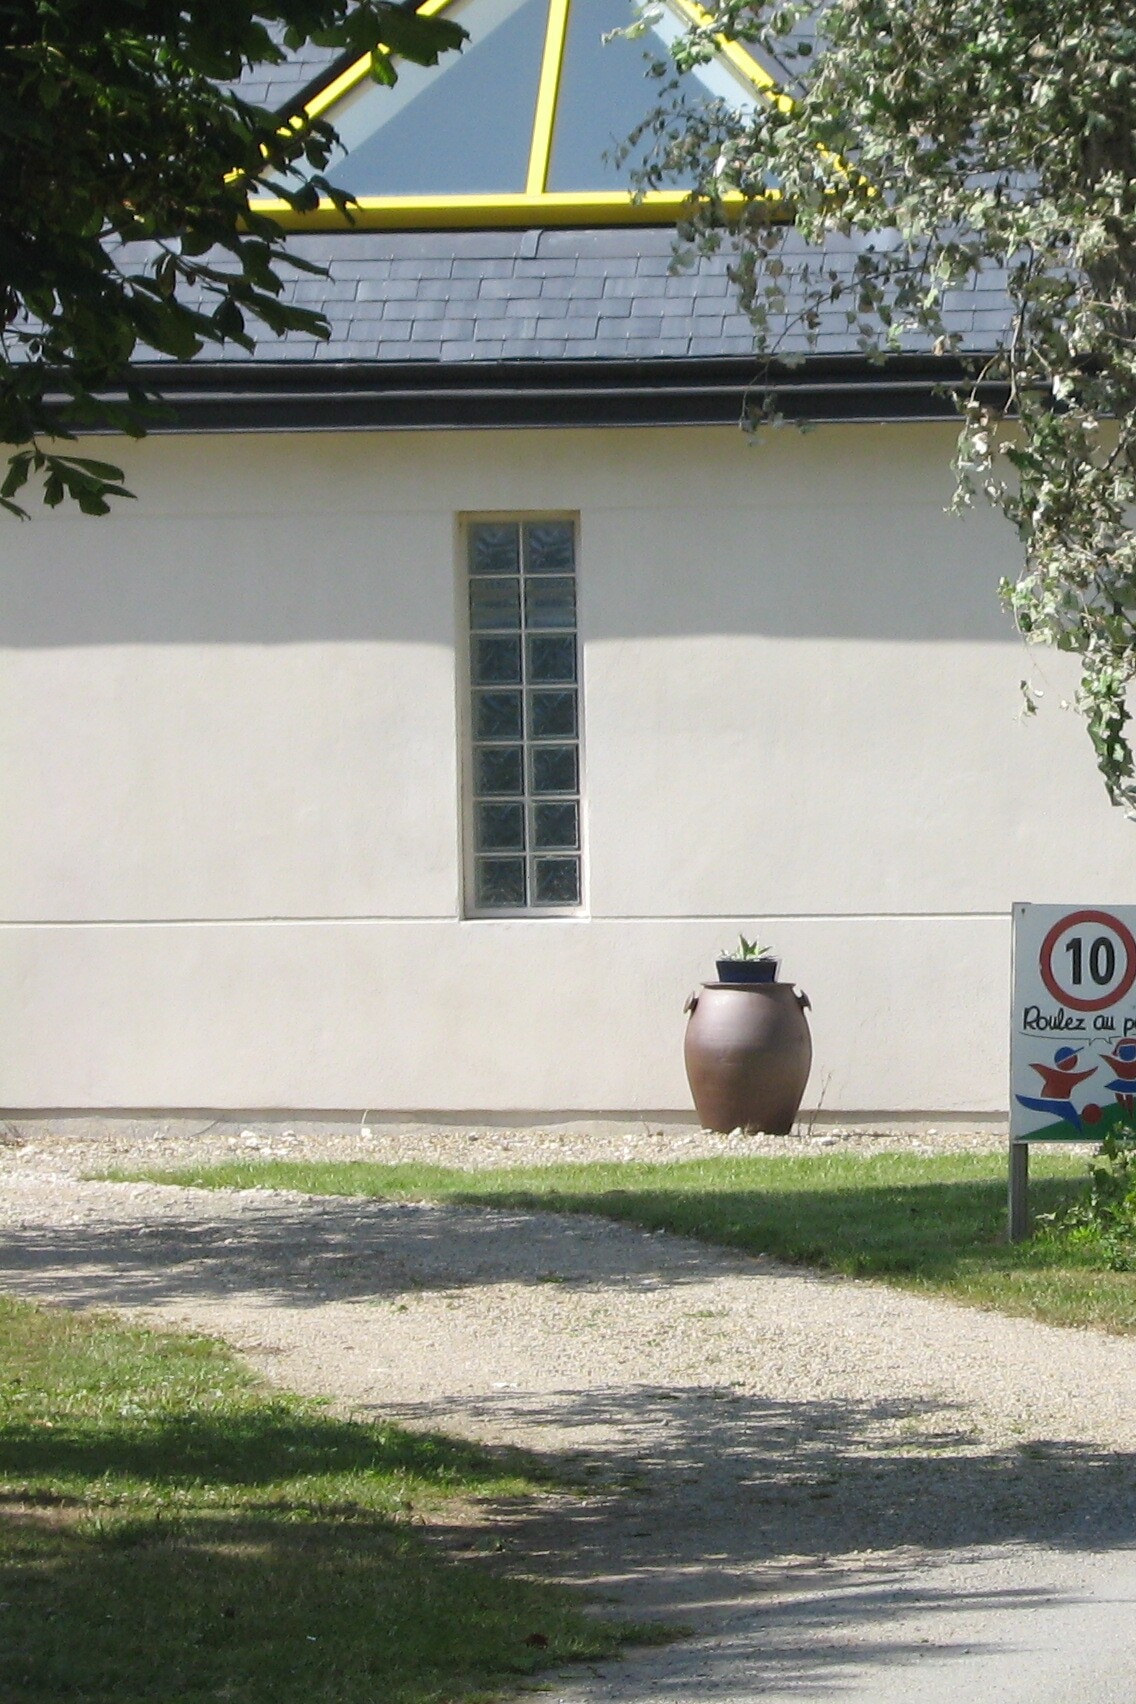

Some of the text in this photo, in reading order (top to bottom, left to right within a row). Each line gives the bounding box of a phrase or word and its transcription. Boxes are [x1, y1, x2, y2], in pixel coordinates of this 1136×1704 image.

[1065, 936, 1116, 986] 10
[1023, 1005, 1086, 1031] Roulez
[1093, 1014, 1115, 1031] au
